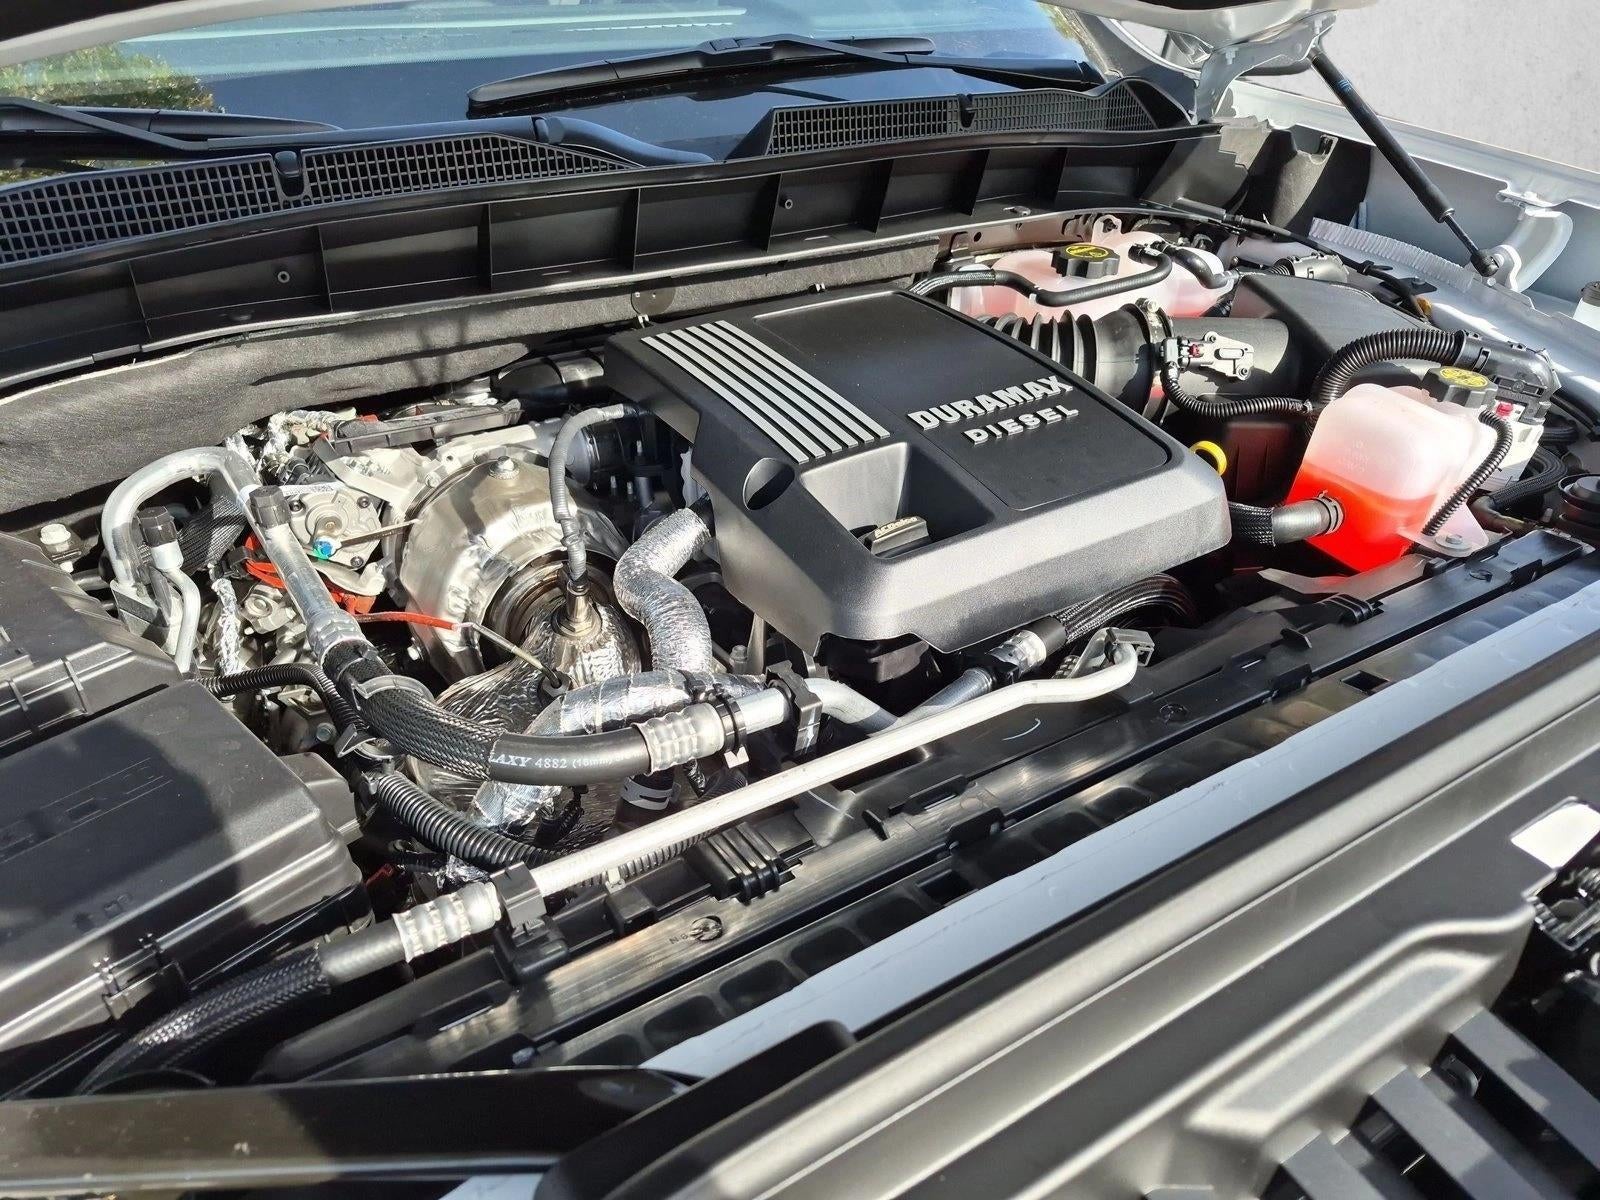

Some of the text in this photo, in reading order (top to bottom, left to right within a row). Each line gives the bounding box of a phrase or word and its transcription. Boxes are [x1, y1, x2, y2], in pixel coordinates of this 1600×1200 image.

[907, 375, 1073, 430] DURAMAX
[962, 405, 1079, 445] DIESEL
[534, 757, 567, 769] 4882
